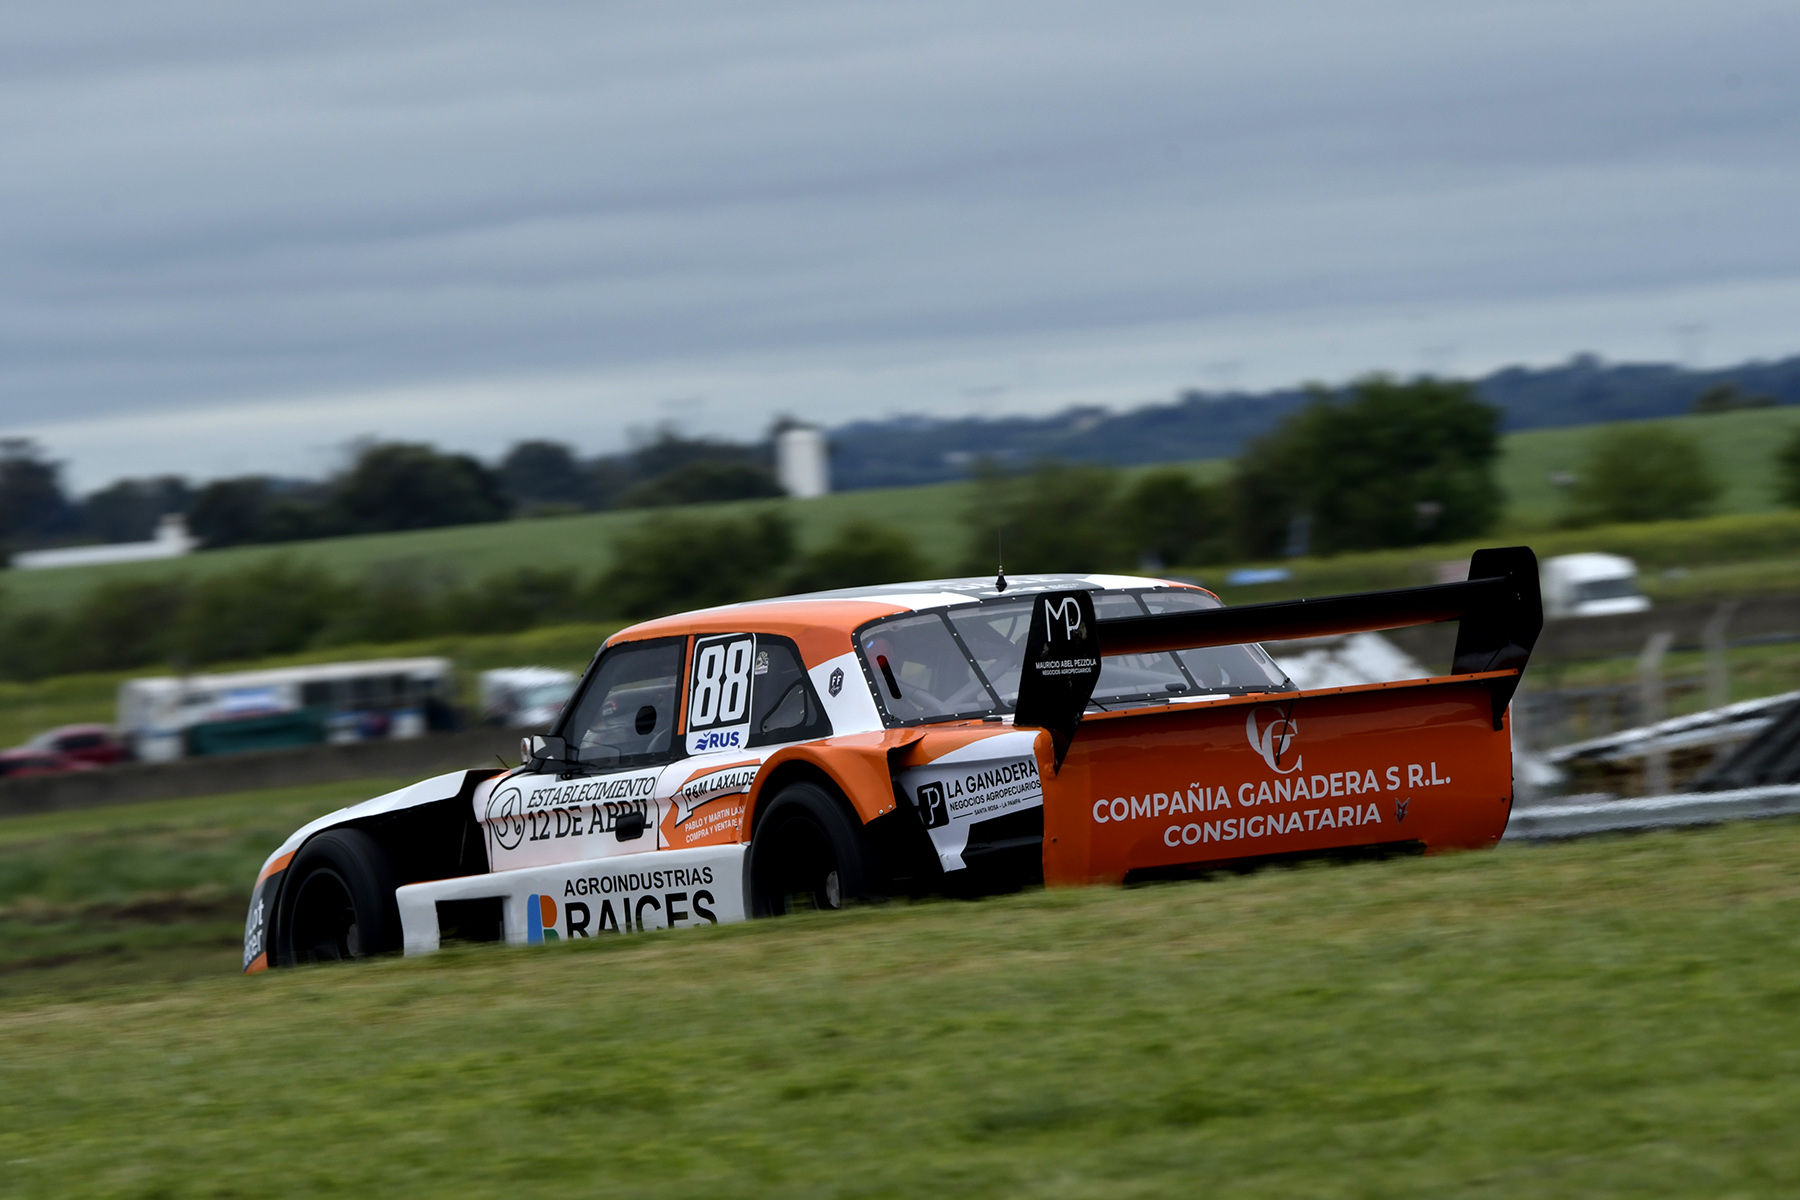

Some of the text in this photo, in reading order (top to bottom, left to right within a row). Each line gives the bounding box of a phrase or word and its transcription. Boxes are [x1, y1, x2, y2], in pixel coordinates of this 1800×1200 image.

[1044, 597, 1081, 642] MP
[1035, 658, 1097, 669] MAURICIO ABEL PEZZOLA
[691, 640, 752, 727] 88
[709, 731, 739, 748] RUS
[526, 776, 656, 809] ESTABLECIMIENTO
[685, 772, 756, 802] P&M LAXALDE
[946, 760, 1038, 799] LA GANADERA
[949, 779, 1042, 812] NEGOCIOS AGROPECUARIOS
[1092, 782, 1232, 824] COMPAÑIA
[1238, 769, 1380, 807] GANADERA
[1407, 761, 1451, 788] R.L.
[527, 810, 551, 841] 12
[551, 805, 583, 838] DE
[685, 817, 703, 832] PABLO
[703, 813, 708, 823] Y
[708, 807, 731, 823] MARTIN
[974, 808, 988, 816] SANTA
[989, 804, 999, 812] ROSA
[1163, 803, 1382, 847] CONSIGNATARIA
[686, 829, 709, 843] COMPRA
[709, 824, 714, 834] Y
[714, 820, 733, 832] VENTA
[564, 866, 714, 897] AGROINDUSTRIAS
[564, 889, 718, 939] RAICES
